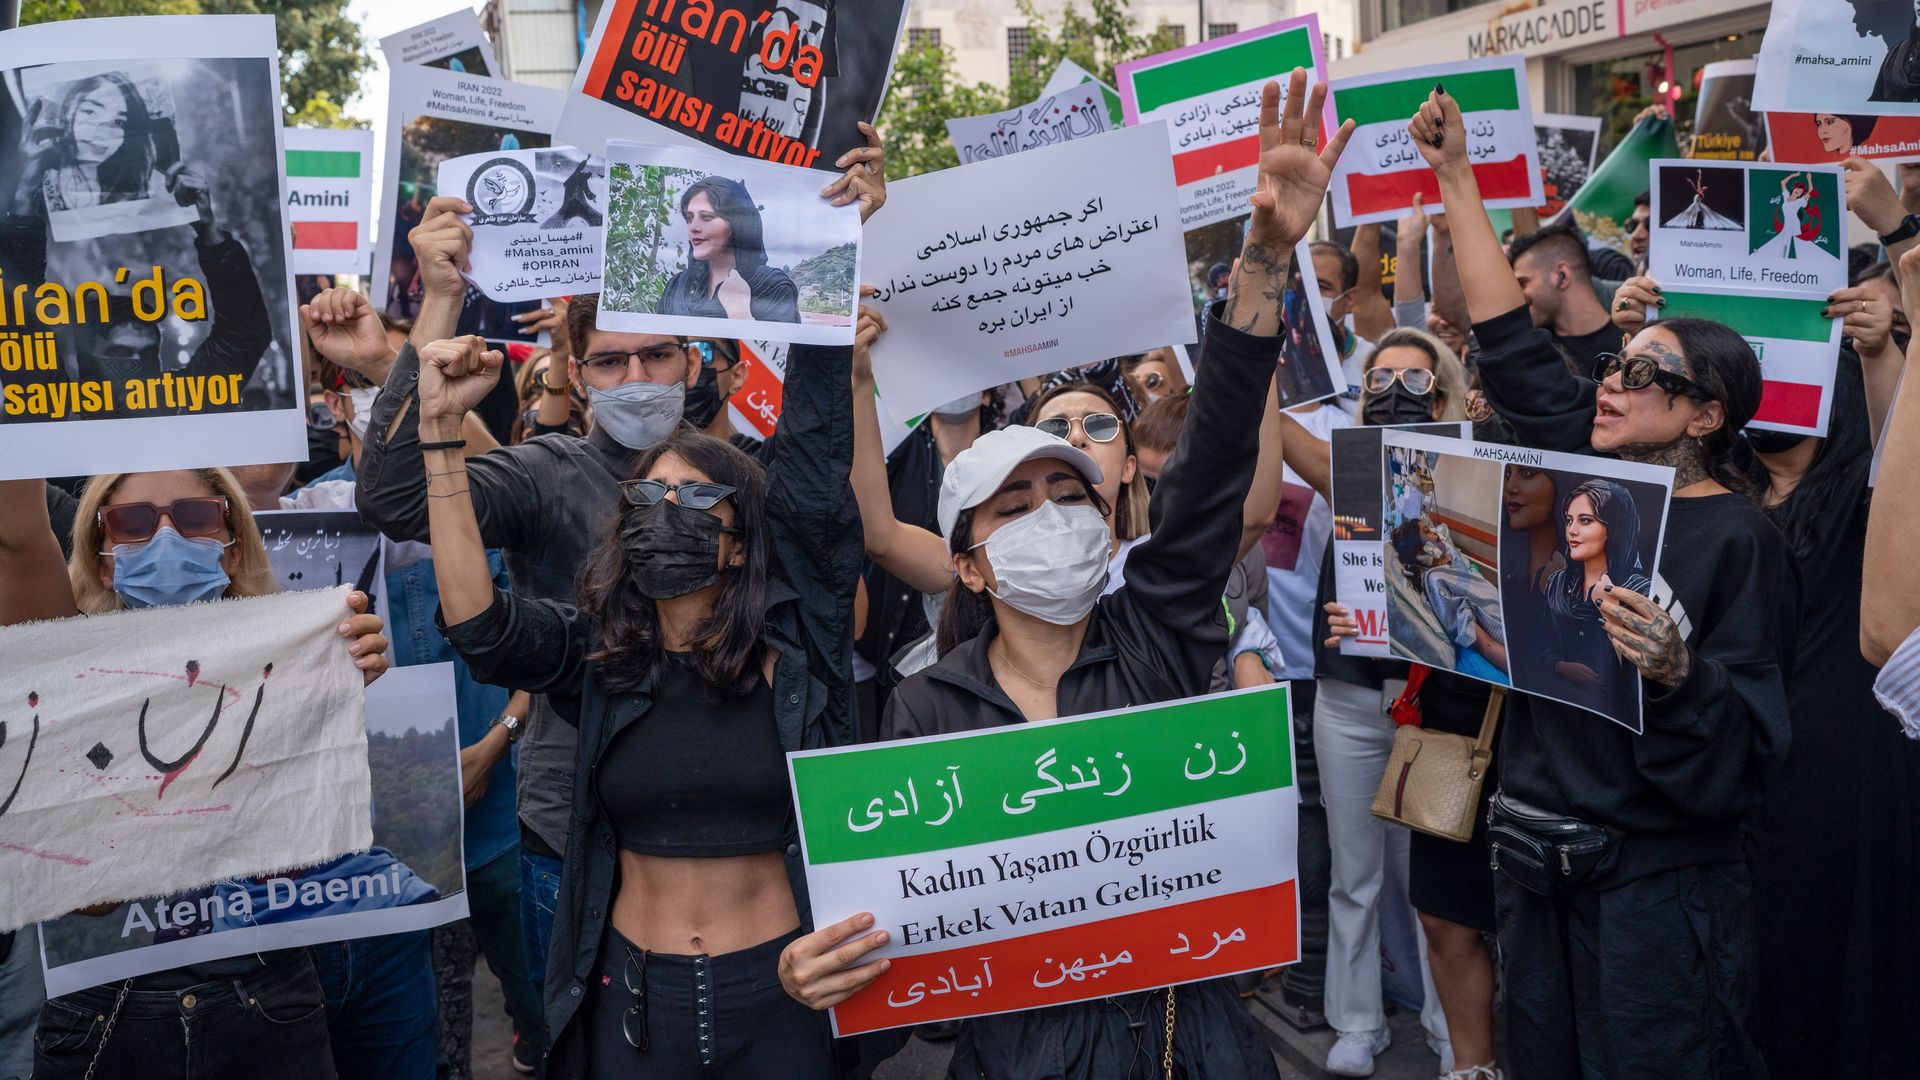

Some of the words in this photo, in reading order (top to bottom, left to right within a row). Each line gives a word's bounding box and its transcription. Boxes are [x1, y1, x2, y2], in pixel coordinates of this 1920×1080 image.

[631, 21, 689, 76] ölü
[1794, 54, 1873, 67] #mahsa_amini
[432, 89, 466, 103] Woman,
[470, 95, 487, 107] Life,
[489, 99, 526, 113] Freedom
[457, 81, 480, 93] IRAN
[481, 85, 503, 97] 2022
[426, 101, 486, 117] #MahsaAmini
[615, 70, 714, 134] sayısı
[288, 190, 349, 207] Amini
[1194, 186, 1214, 199] IRAN
[1215, 180, 1236, 193] 2022
[993, 211, 1073, 242] جمهوری
[1089, 214, 1160, 251] اعتراض
[504, 244, 594, 259] #Mahsa_amini
[917, 225, 987, 261] اسلامی
[1046, 236, 1084, 260] های
[1680, 240, 1723, 250] MahsaAmini
[522, 259, 580, 272] #OPIRAN
[984, 256, 998, 276] را
[1002, 250, 1042, 275] مردم
[1077, 258, 1112, 283] خب
[1675, 263, 1726, 281] Woman,
[1730, 266, 1757, 283] Life,
[1761, 268, 1819, 285] Freedom
[921, 264, 978, 286] دوست
[1012, 270, 1073, 294] میتونه
[931, 294, 961, 314] کنه
[966, 288, 1007, 311] جمع
[1058, 296, 1074, 318] از
[978, 315, 1006, 333] بره
[1010, 300, 1053, 328] ایران
[0, 331, 58, 373] ölü
[1003, 338, 1060, 359] #MAHSAAMINI
[3, 381, 114, 419] sayısı
[125, 372, 244, 411] artıyor
[1342, 552, 1368, 567] She
[1364, 578, 1385, 593] We
[1184, 731, 1247, 781] زن
[1002, 747, 1132, 815] زندگی
[847, 765, 964, 833] آزادی
[898, 860, 986, 899] Kadın
[988, 848, 1080, 884] Yaşam
[1085, 813, 1218, 867] Özgürlük
[120, 891, 251, 938] Atena
[266, 864, 400, 912] Daemi
[900, 907, 995, 947] Erkek
[997, 894, 1089, 926] Vatan
[1096, 867, 1223, 907] Gelişme
[1169, 926, 1246, 961] مرد
[1032, 950, 1133, 989] میهن
[887, 956, 993, 1008] آبادی
